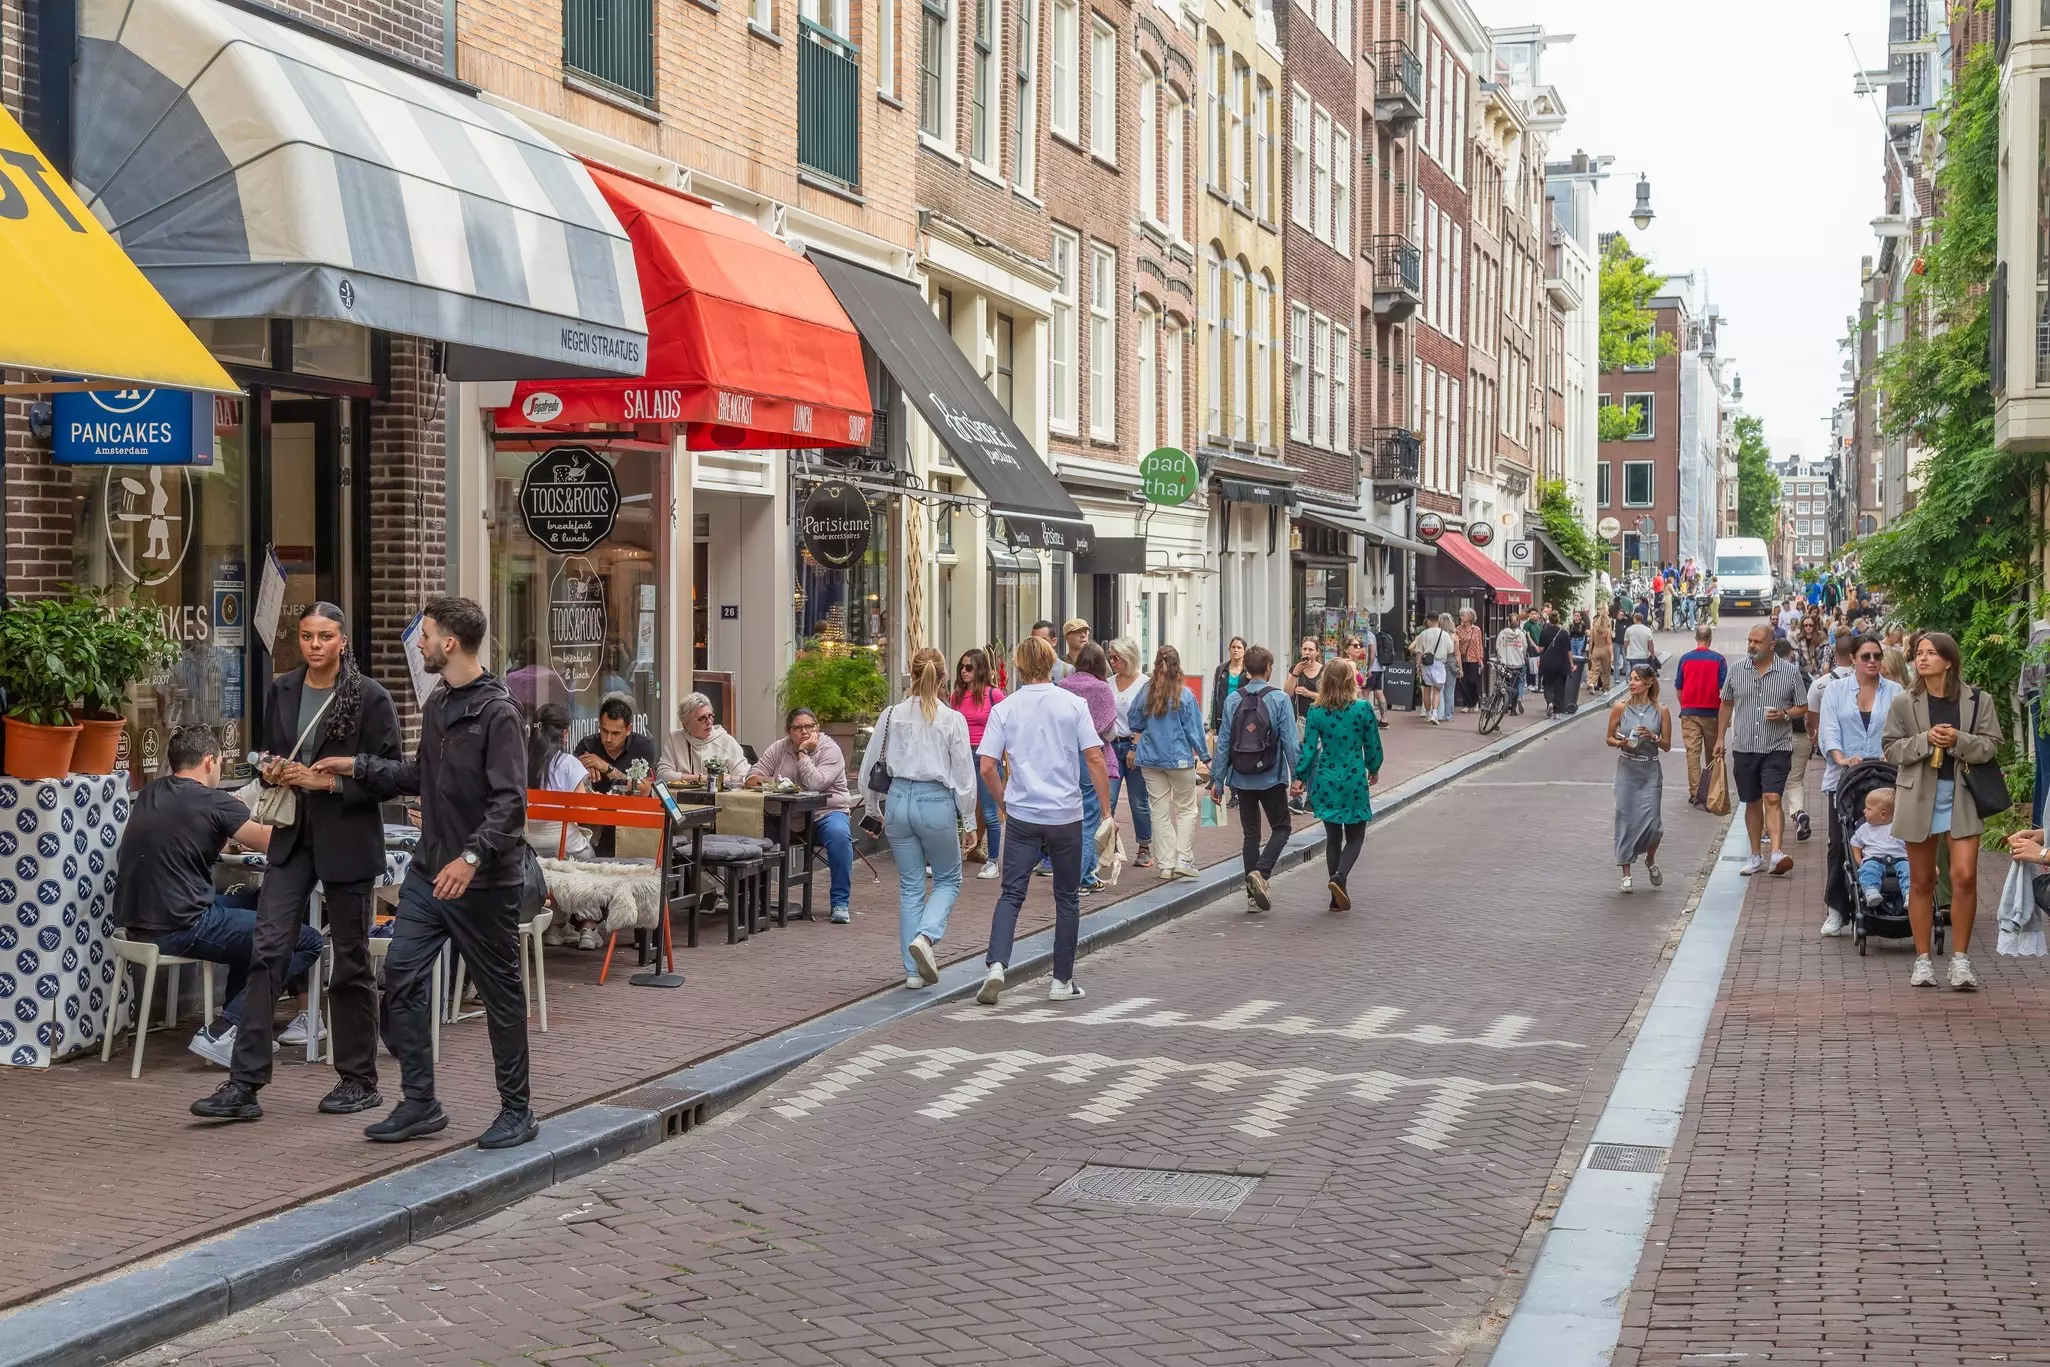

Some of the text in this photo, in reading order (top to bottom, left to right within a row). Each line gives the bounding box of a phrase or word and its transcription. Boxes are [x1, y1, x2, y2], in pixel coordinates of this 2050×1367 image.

[561, 327, 639, 362] NEGEN STRAATJES
[526, 397, 560, 415] Segafredo
[624, 389, 681, 419] SALADS
[717, 391, 754, 425] BREAKFAST
[792, 404, 813, 433] LUNCH
[71, 422, 172, 443] PANCAKES
[848, 415, 866, 442] SOUPS
[95, 446, 149, 455] Amsterdam
[1147, 456, 1186, 474] pad
[1145, 477, 1185, 497] thai
[530, 486, 609, 514] TOOS&ROOS
[547, 520, 593, 534] breakfast
[803, 516, 870, 535] Parisienne
[550, 533, 590, 543] & lunch
[723, 607, 735, 617] 26
[552, 607, 602, 642] TOOS&ROOS
[561, 651, 592, 668] breakfast
[564, 667, 591, 680] & lunch
[115, 760, 130, 770] OPEN
[143, 757, 159, 767] LOCAL
[38, 787, 55, 805] 15
[101, 826, 113, 843] 15
[63, 949, 74, 967] 15
